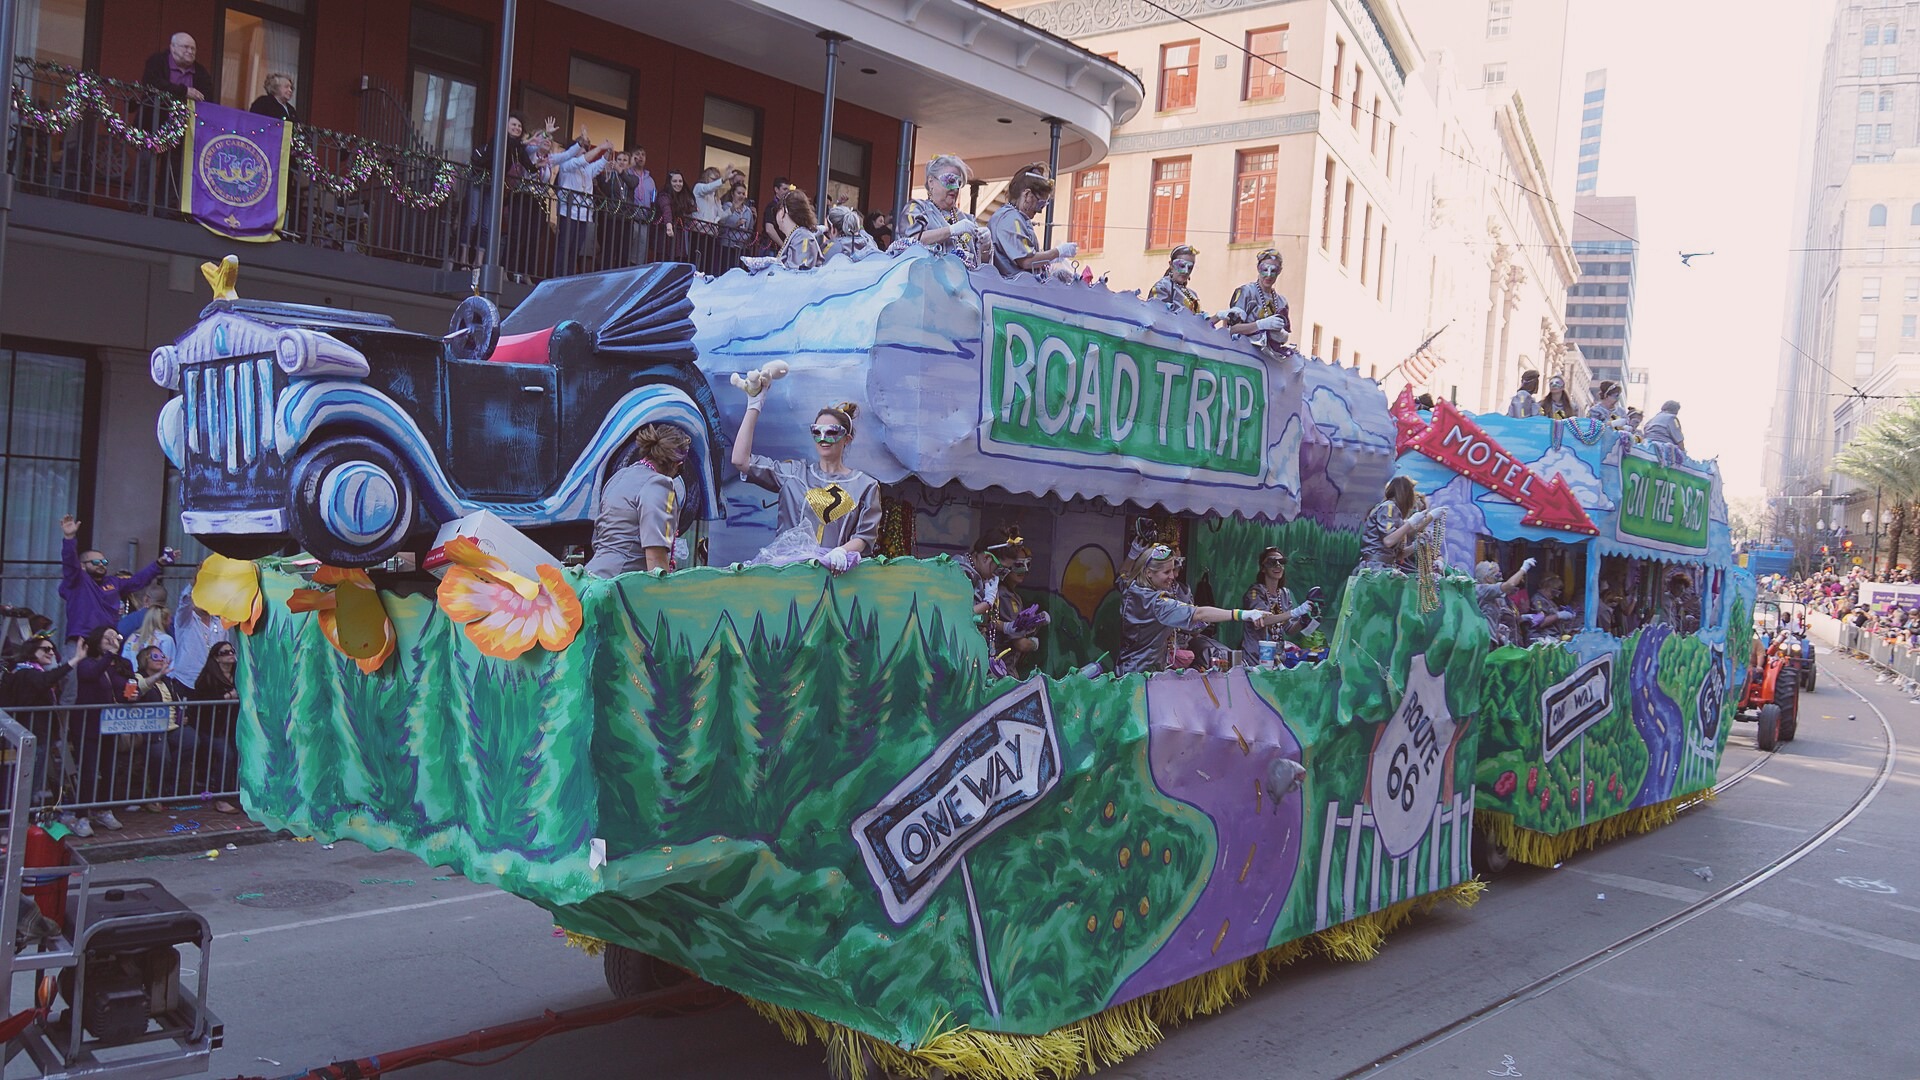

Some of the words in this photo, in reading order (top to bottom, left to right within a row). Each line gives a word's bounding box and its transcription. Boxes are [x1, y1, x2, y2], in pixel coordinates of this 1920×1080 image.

[1001, 321, 1140, 443] ROAD
[1156, 360, 1254, 461] TRIP
[1443, 424, 1535, 497] MOTEL
[1652, 479, 1676, 523] THE
[1574, 683, 1593, 709] WAY
[1402, 691, 1440, 776] ROUTE
[901, 784, 975, 865] ONE
[960, 734, 1024, 807] WAY
[1386, 743, 1420, 812] 66
